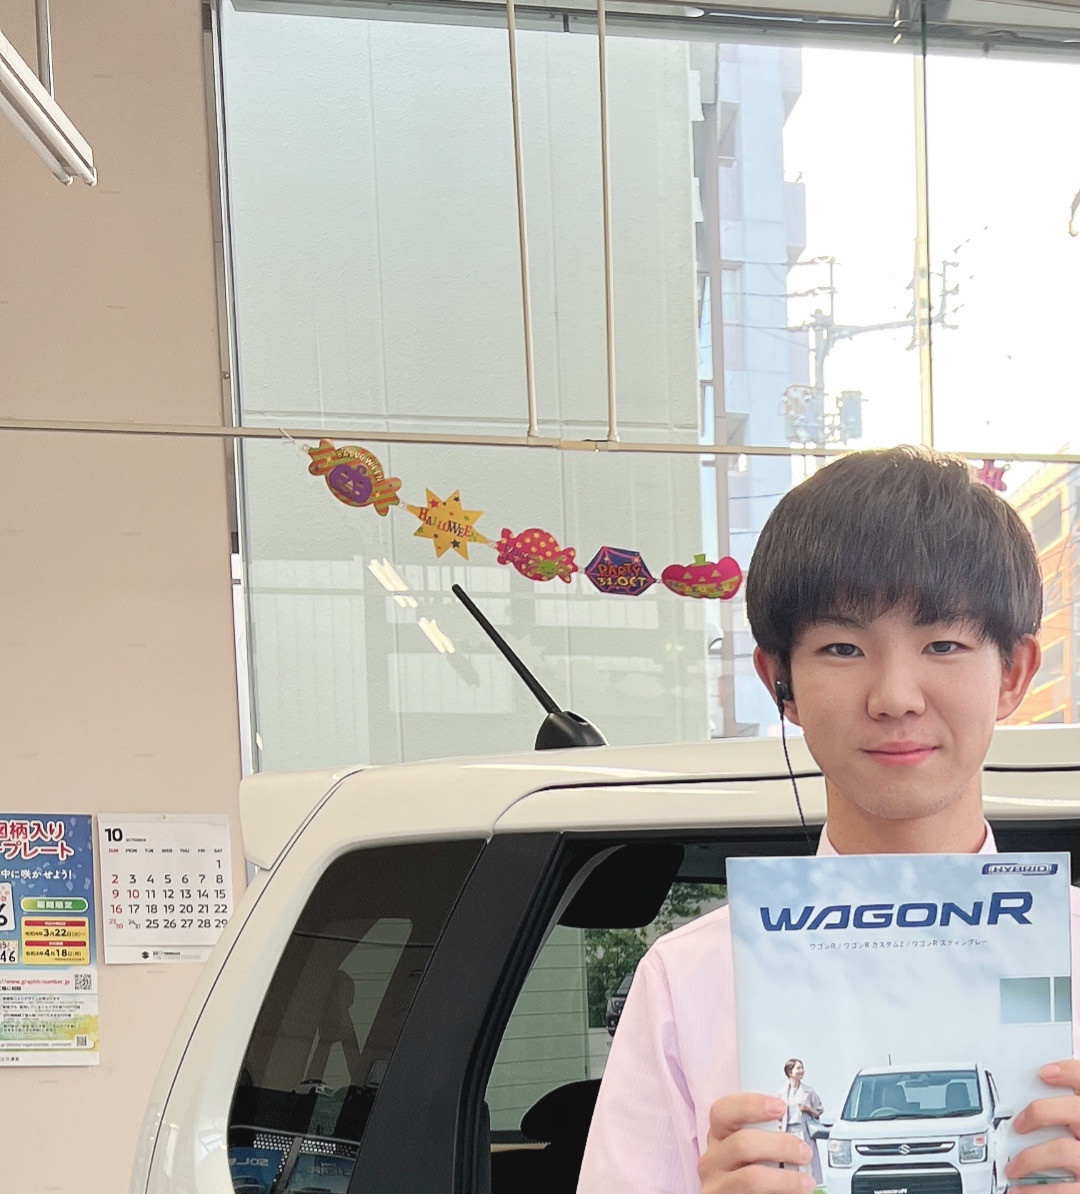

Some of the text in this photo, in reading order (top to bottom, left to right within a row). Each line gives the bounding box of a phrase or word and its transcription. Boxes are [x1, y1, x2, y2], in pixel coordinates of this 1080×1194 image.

[418, 507, 479, 543] HALLOWEEN
[597, 563, 642, 578] PARTY
[104, 828, 123, 842] 10
[0, 841, 73, 859] プレート
[216, 859, 221, 869] 1
[991, 864, 1049, 874] HYBRID
[112, 874, 223, 884] 2 3 4 5 6 7 8
[112, 889, 226, 899] 9 10 11 12 13 14 15
[110, 904, 228, 914] 16 17 18 19 20 21 22
[145, 919, 159, 929] 25
[163, 919, 177, 929] 26
[180, 919, 193, 929] 27
[197, 919, 211, 929] 28
[214, 919, 228, 929] 29
